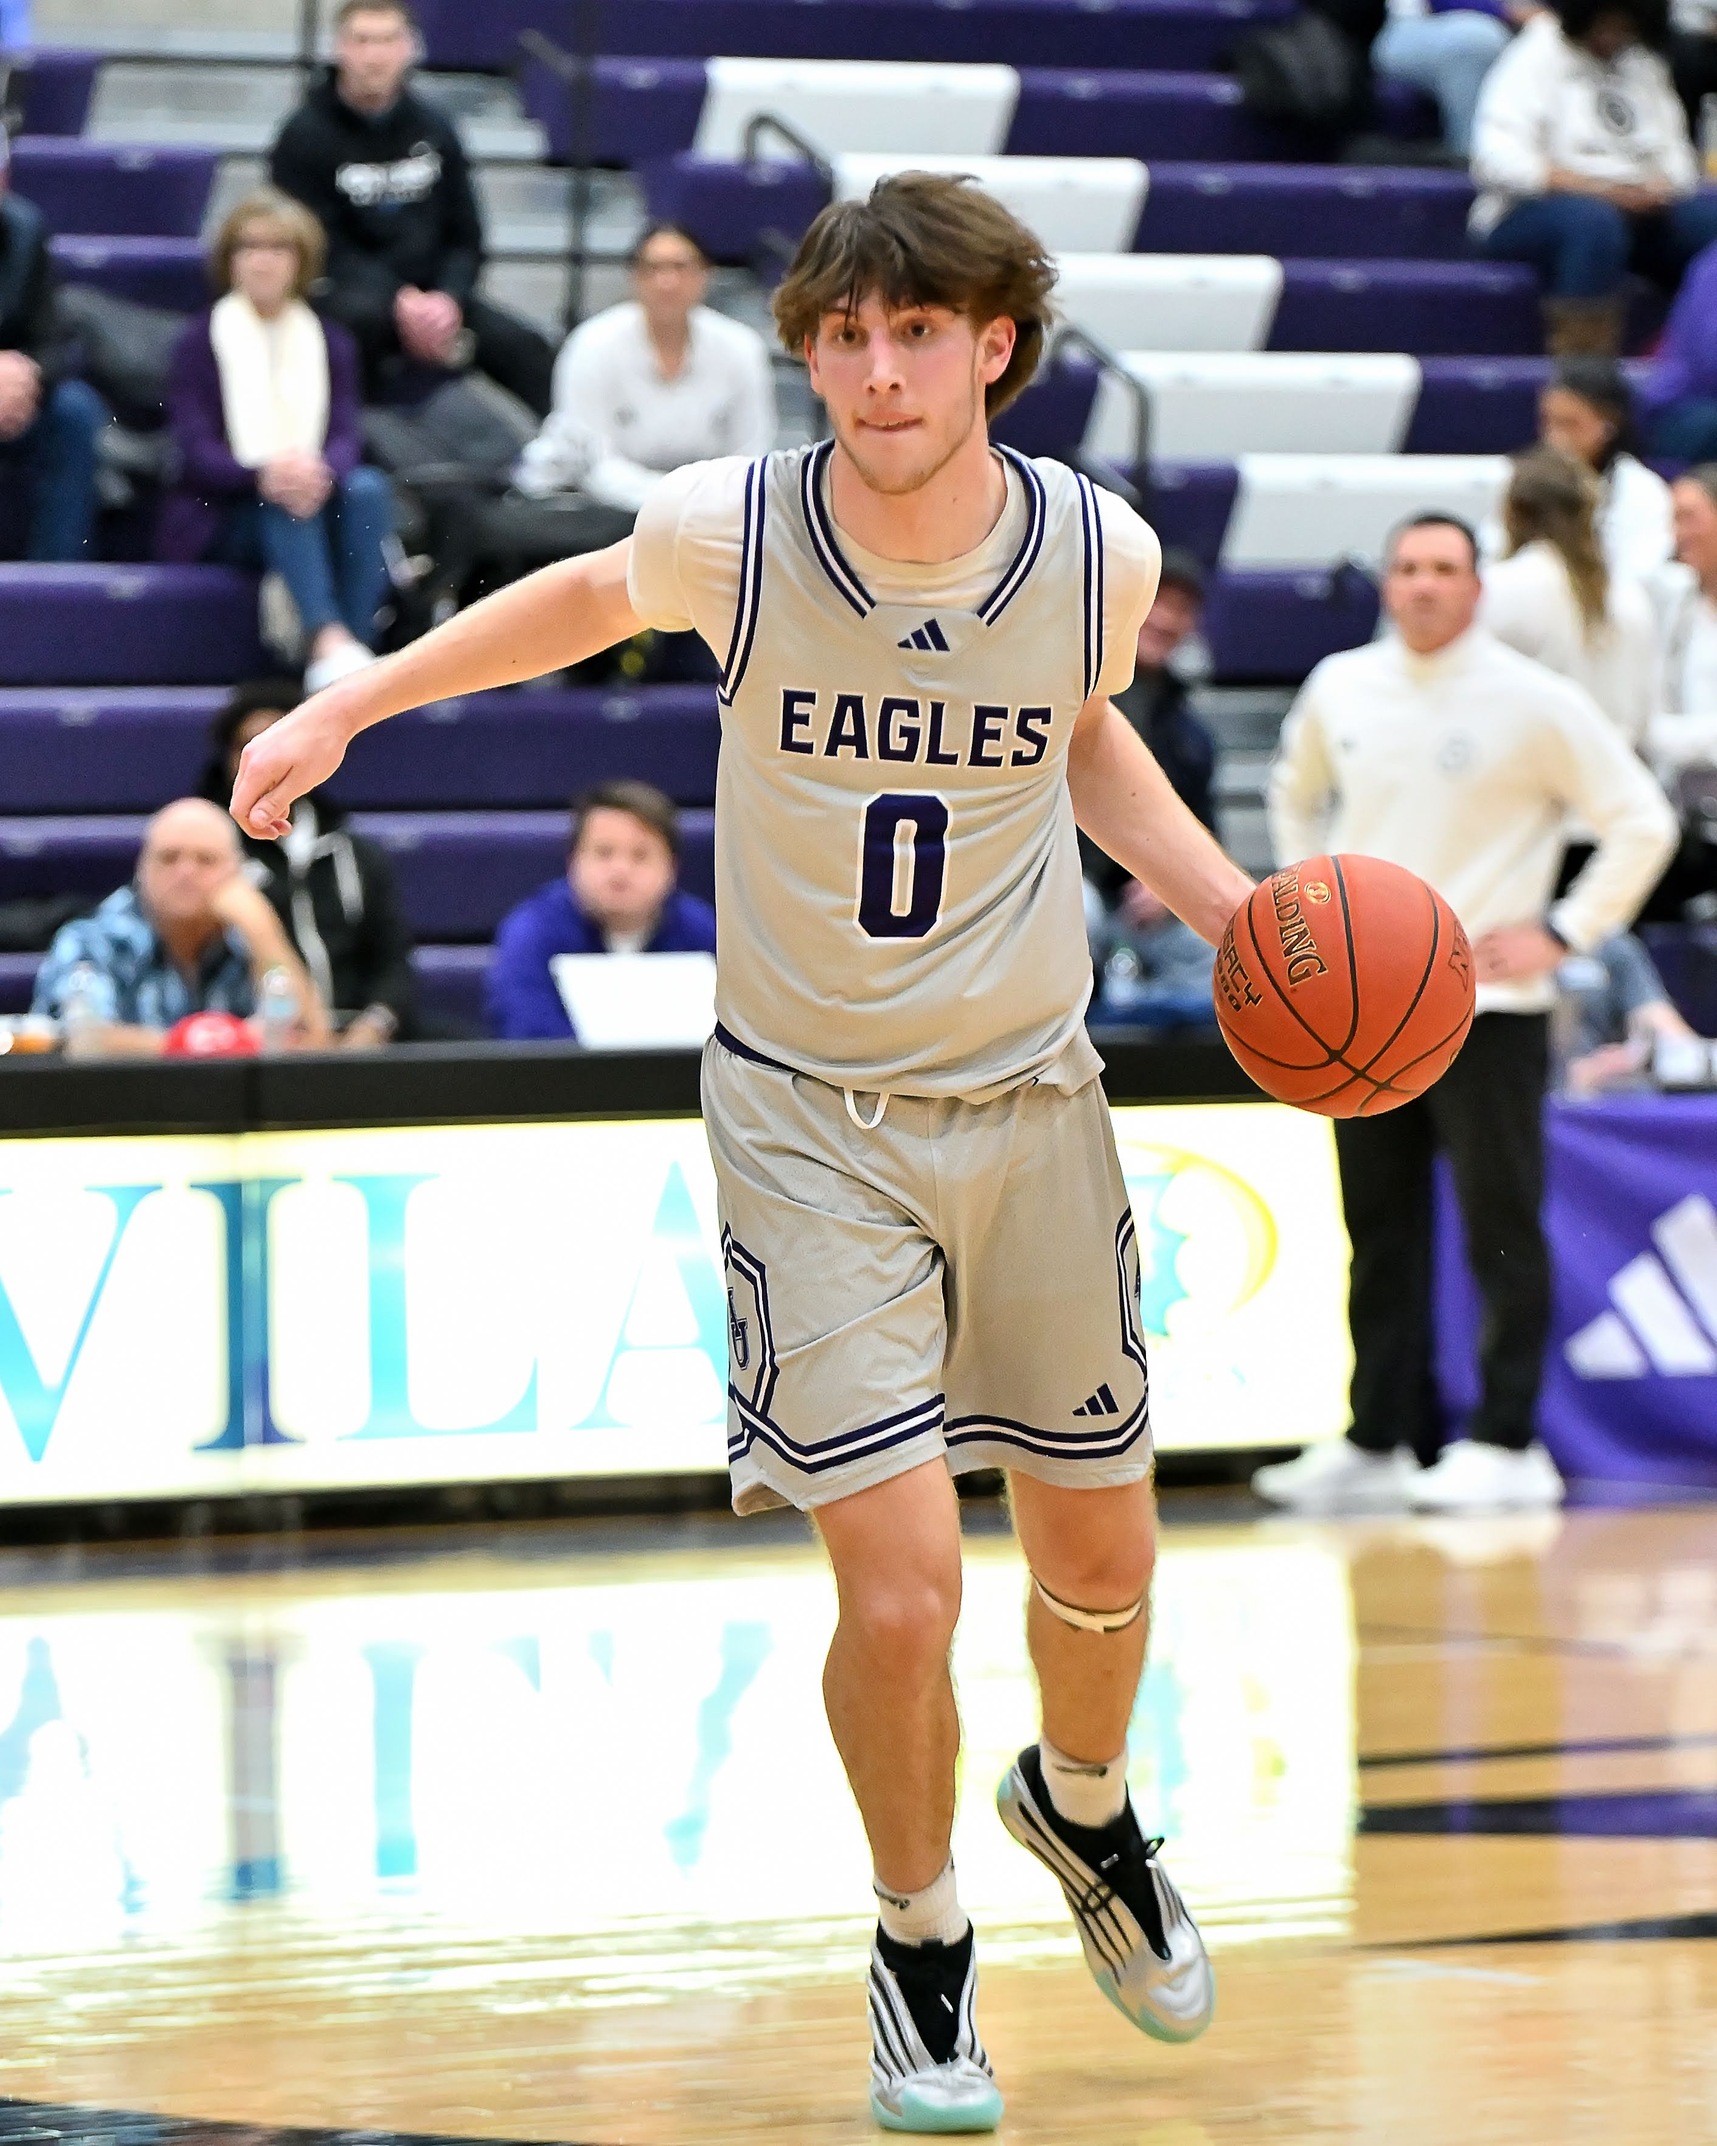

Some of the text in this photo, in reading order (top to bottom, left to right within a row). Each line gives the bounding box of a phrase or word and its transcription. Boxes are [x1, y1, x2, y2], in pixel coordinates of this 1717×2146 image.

[779, 686, 1054, 768] EAGLES
[853, 788, 951, 941] 0
[1270, 860, 1327, 987] PALDING
